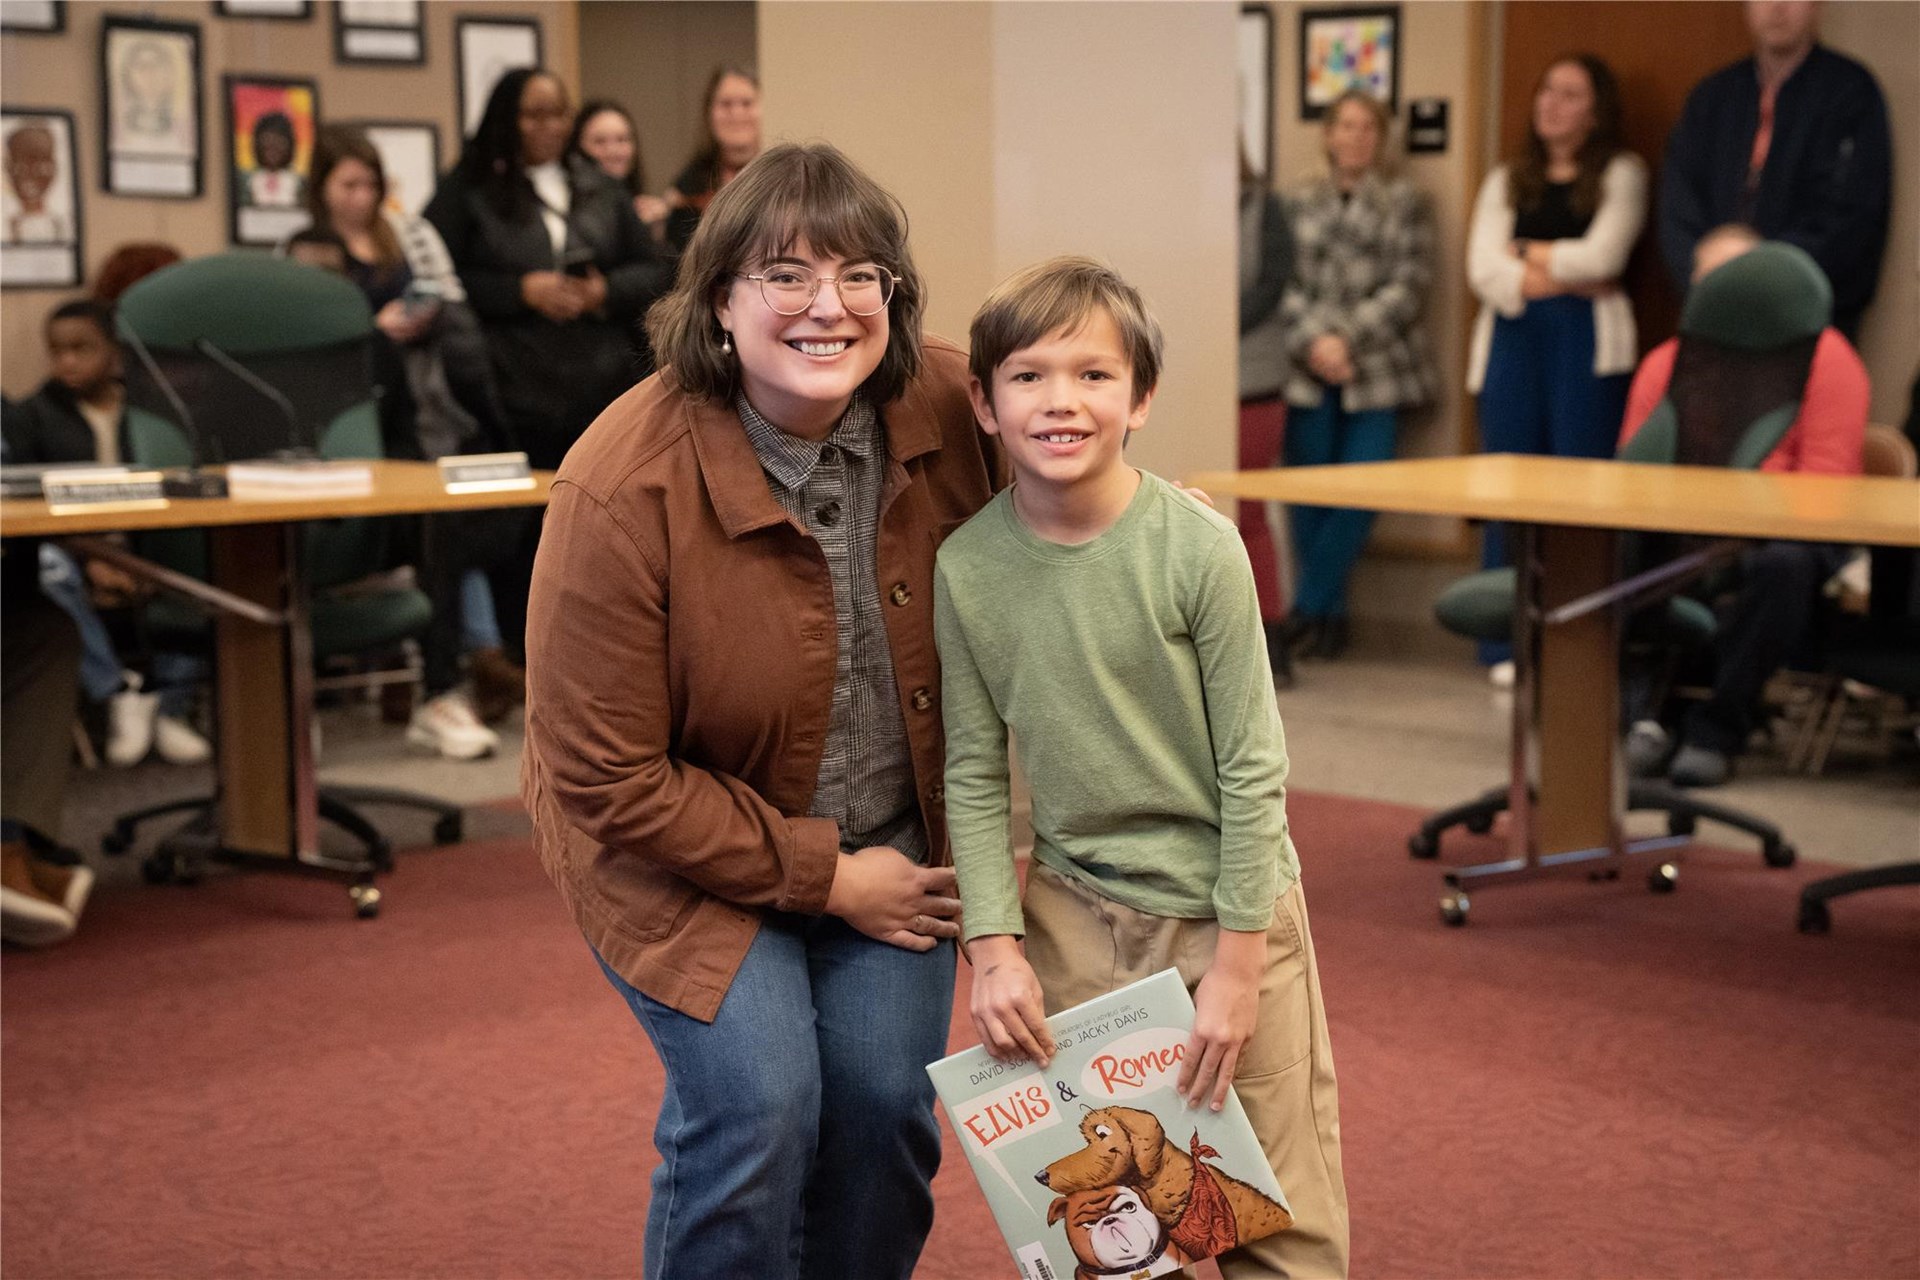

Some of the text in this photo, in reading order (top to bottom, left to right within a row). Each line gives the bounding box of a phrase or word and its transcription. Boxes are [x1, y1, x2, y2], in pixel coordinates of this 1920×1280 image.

[969, 1063, 1004, 1086] DAVID
[1077, 1021, 1111, 1043] JACKY
[1113, 1007, 1149, 1029] DAVIS
[1056, 1080, 1079, 1103] &
